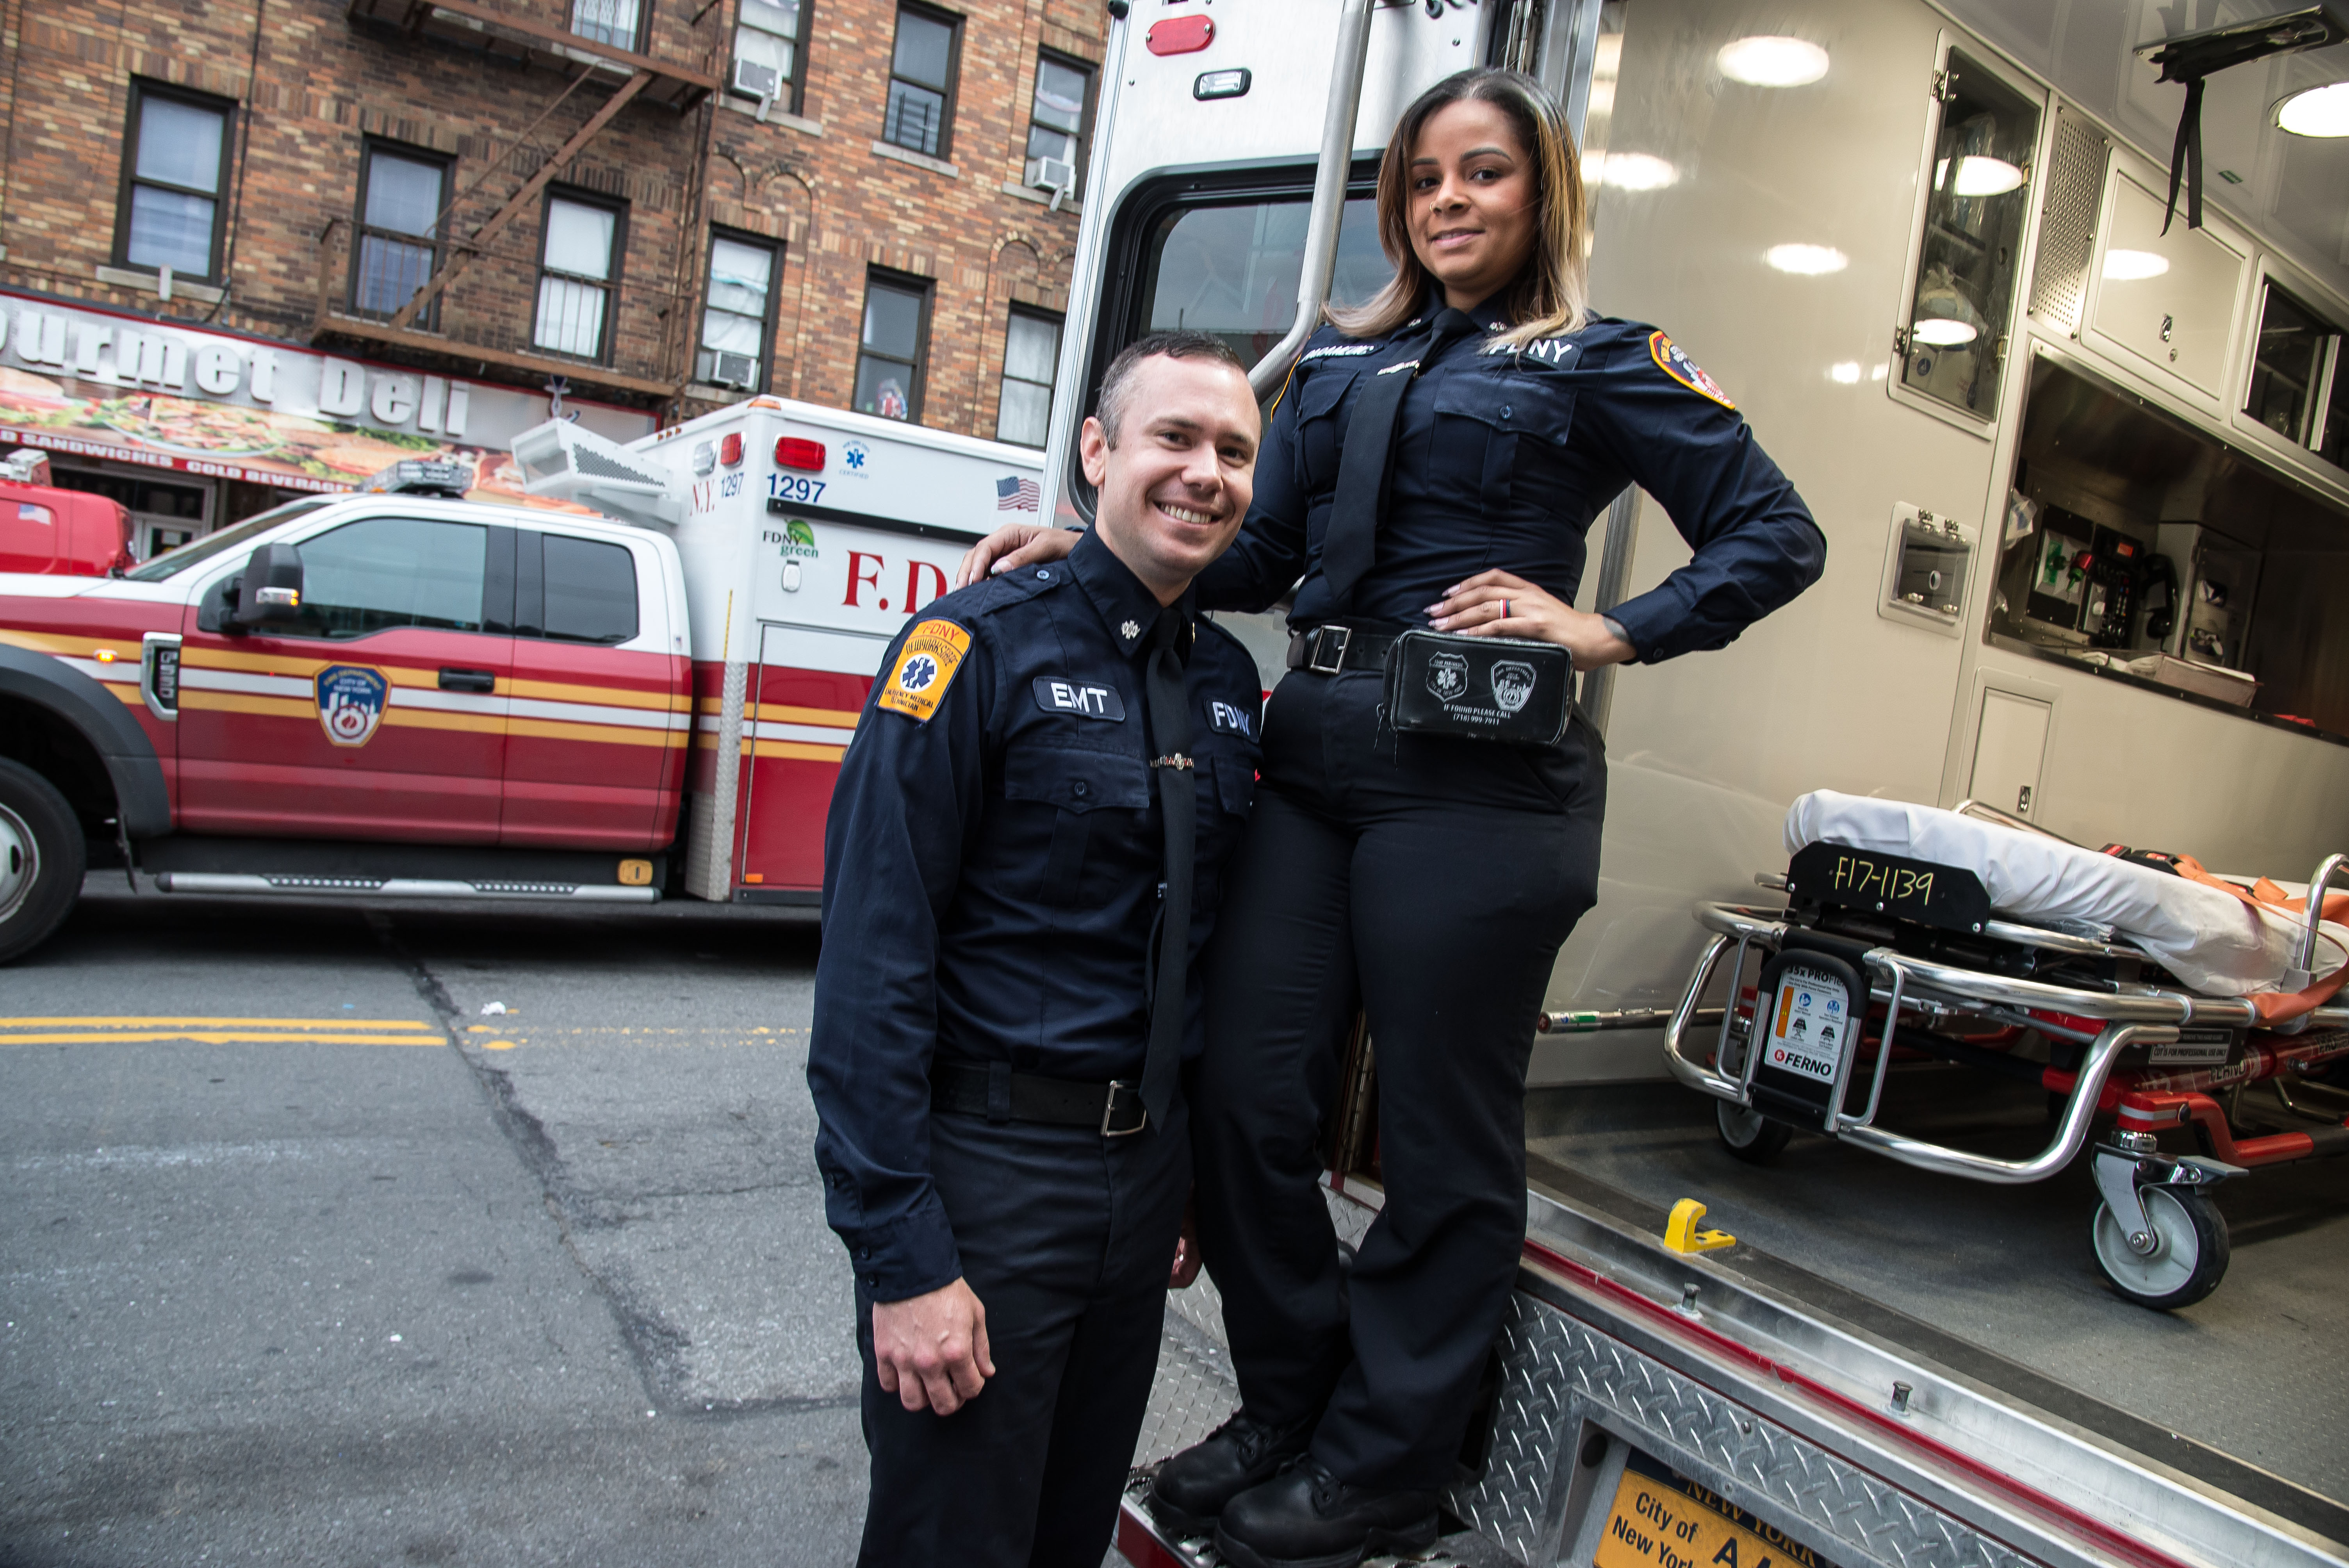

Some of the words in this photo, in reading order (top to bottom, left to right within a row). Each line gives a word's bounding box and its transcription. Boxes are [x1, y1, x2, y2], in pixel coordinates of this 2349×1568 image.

[319, 354, 468, 437] Deli
[21, 432, 173, 467] SANDWICHES
[186, 460, 242, 479] COLD
[690, 479, 715, 517] N.Y.
[721, 472, 744, 499] 1297
[767, 472, 826, 503] 1297
[763, 531, 803, 546] FDNY
[780, 545, 819, 558] green
[922, 623, 959, 641] FDNY
[890, 696, 919, 711] TECHNICIAN
[909, 694, 934, 709] MEDICAL
[1051, 682, 1107, 714] EMT
[1451, 704, 1472, 714] FOUND
[1473, 707, 1495, 717] PLEASE
[1497, 710, 1511, 719] CALL
[1835, 856, 1934, 906] F17-1139
[1784, 1052, 1831, 1076] FERNO
[2154, 1048, 2162, 1056] COT
[2168, 1048, 2177, 1057] FOR
[2177, 1048, 2208, 1057] PROFESSIONAL
[2208, 1048, 2216, 1057] USE
[2216, 1048, 2227, 1057] ONLY
[1636, 1491, 1673, 1531] City
[1676, 1521, 1698, 1543] of
[1612, 1514, 1654, 1555] New
